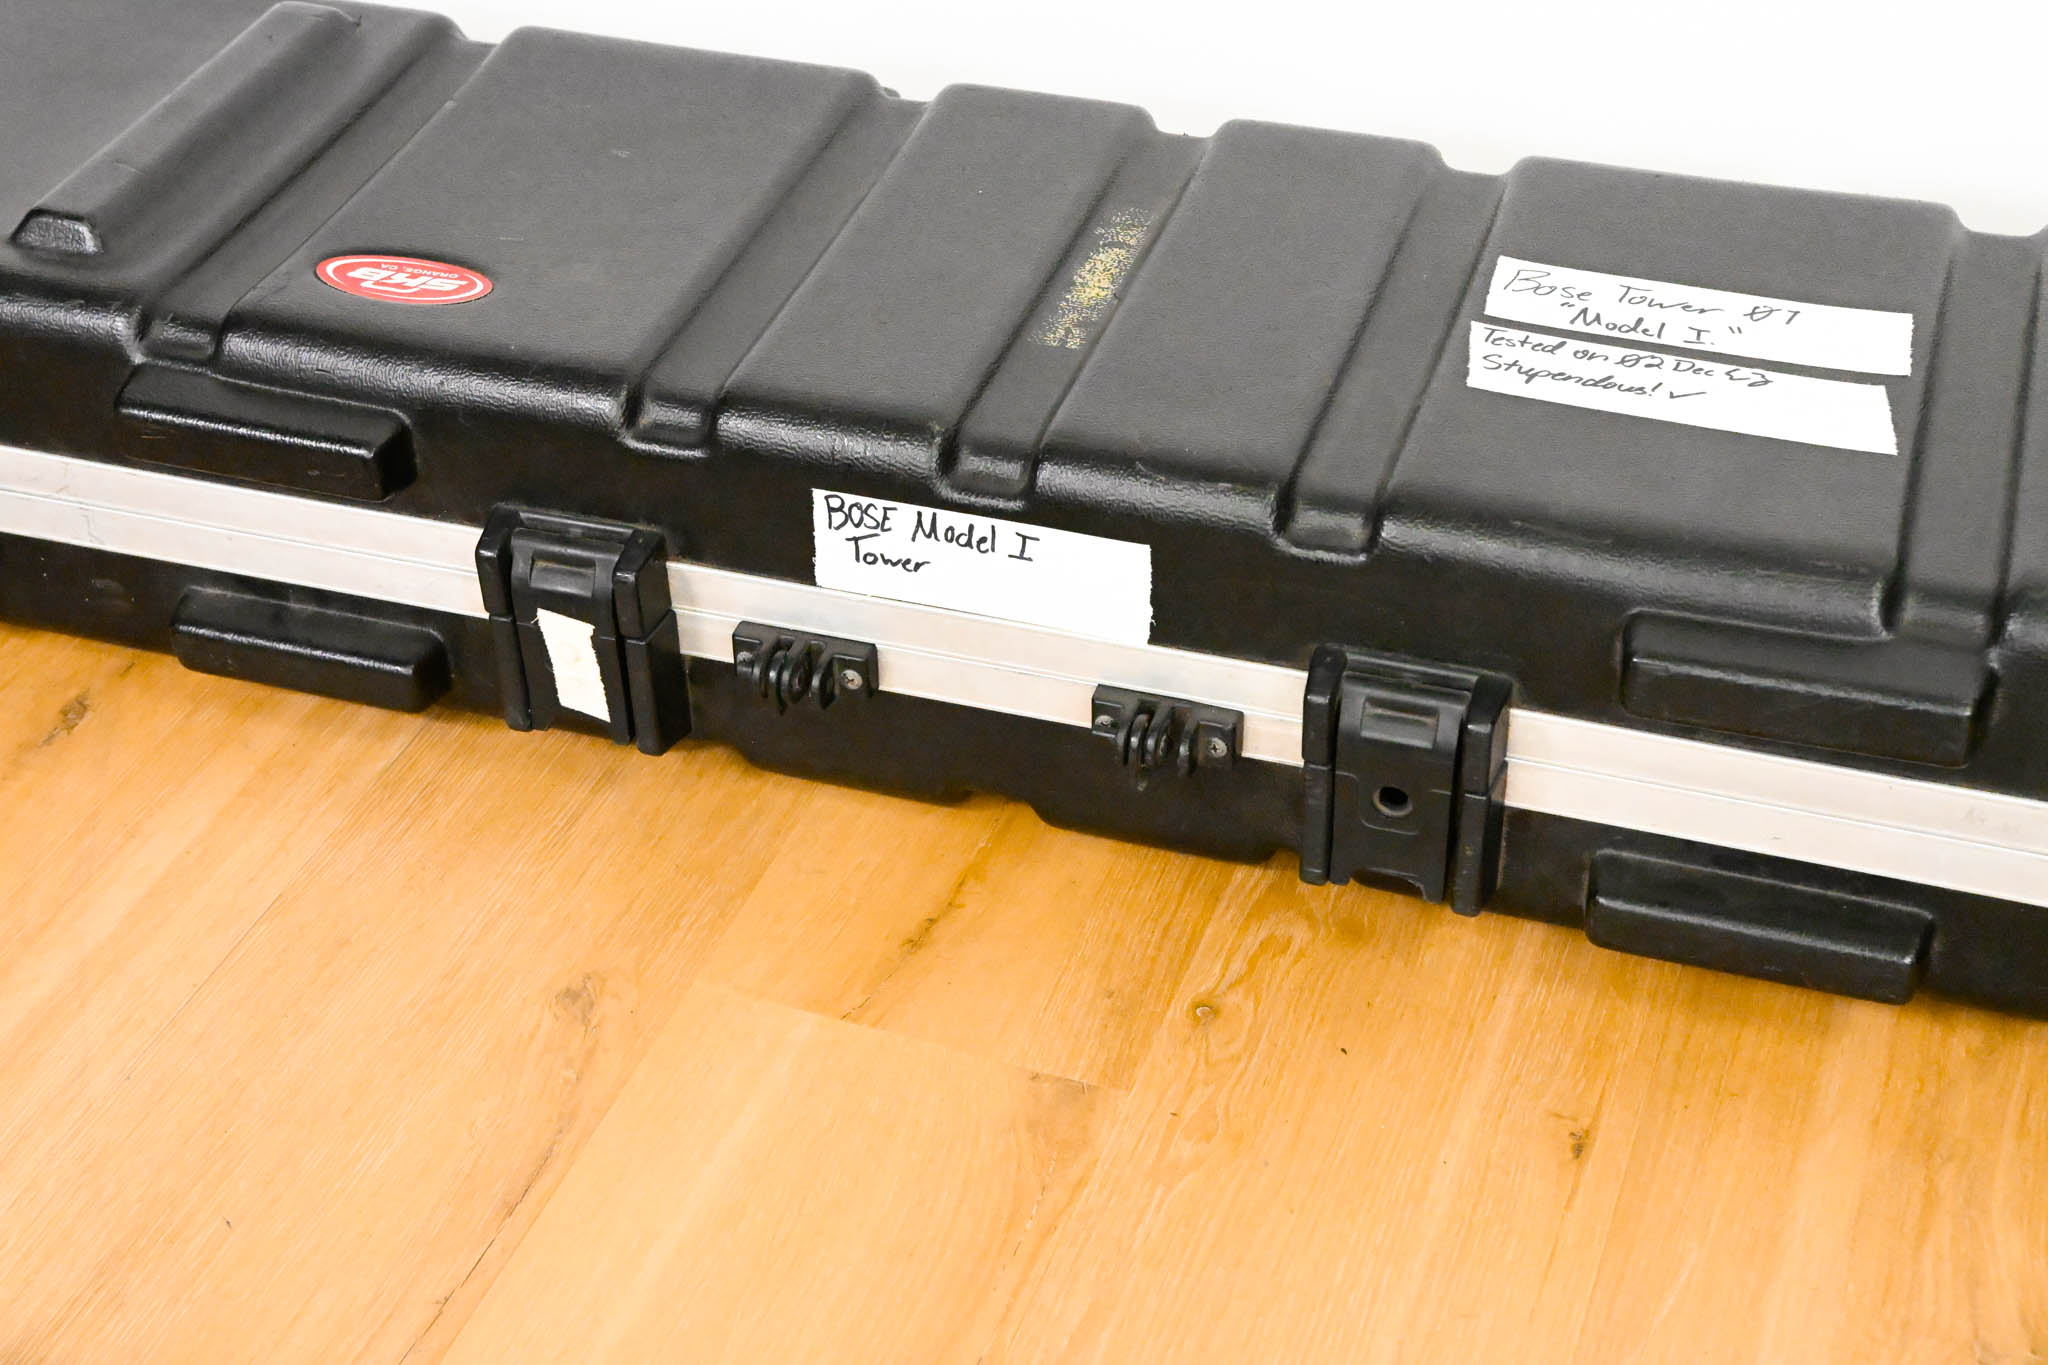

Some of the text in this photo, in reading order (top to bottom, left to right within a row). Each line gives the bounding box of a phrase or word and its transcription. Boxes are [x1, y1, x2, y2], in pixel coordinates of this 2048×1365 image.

[347, 267, 469, 291] SKB
[381, 263, 398, 271] CA
[1504, 269, 1593, 301] Bose
[1619, 284, 1724, 314] Tower
[1484, 327, 1567, 355] Tested
[1573, 349, 1608, 361] on
[1672, 359, 1715, 377] Dec
[1482, 353, 1664, 397] Stupendous!
[824, 494, 1041, 562] BOSE Model I
[845, 533, 931, 572] Tower
